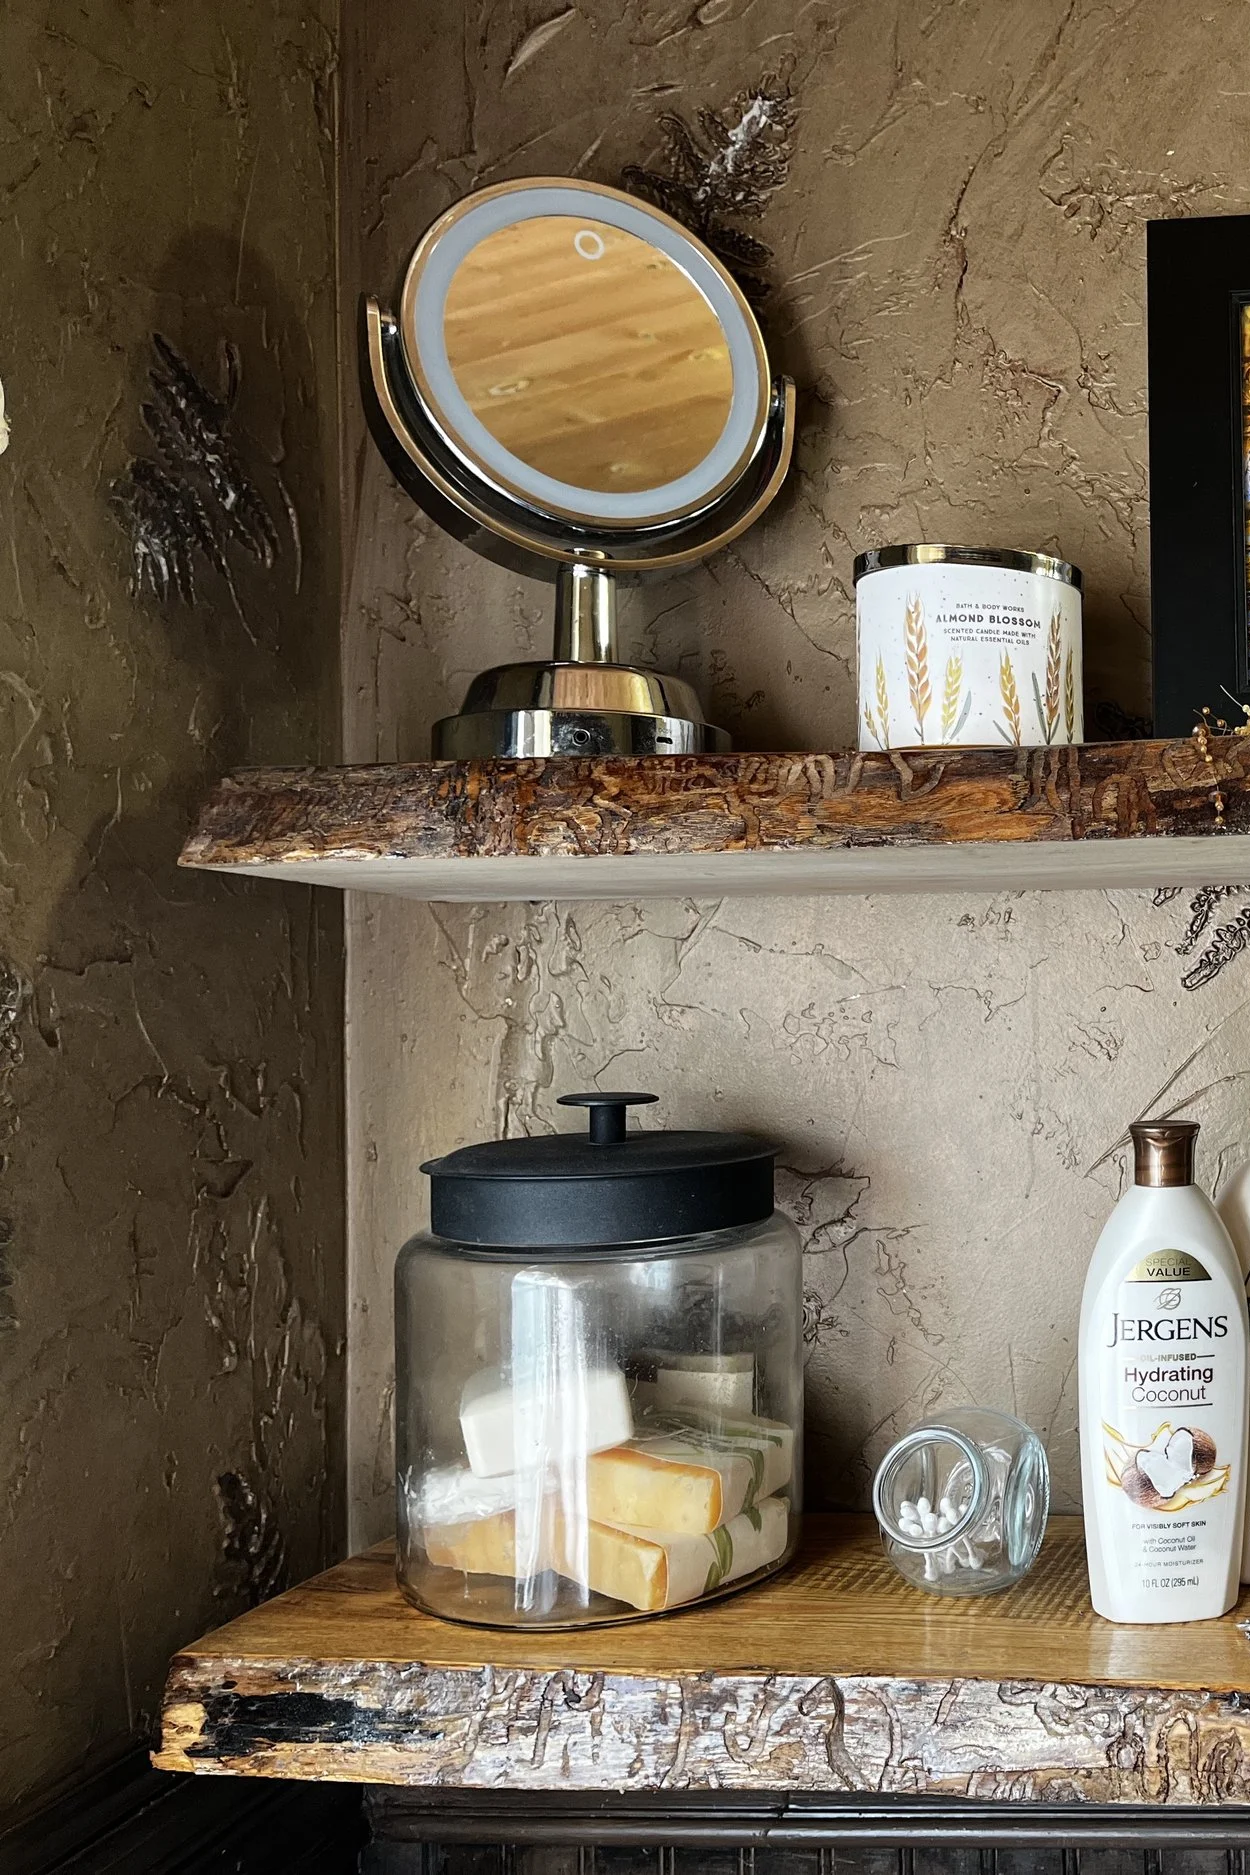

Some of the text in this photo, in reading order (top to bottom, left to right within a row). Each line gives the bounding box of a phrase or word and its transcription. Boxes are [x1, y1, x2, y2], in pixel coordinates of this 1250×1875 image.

[1002, 605, 1024, 613] WORKS
[936, 614, 1041, 629] ALMOND BLOSSOM
[980, 636, 1014, 644] ESSENTIAL
[1021, 631, 1036, 639] WITH
[1145, 1257, 1192, 1267] SPECIAL
[1146, 1267, 1192, 1277] VALUE
[1106, 1312, 1228, 1348] JERGENS
[1124, 1366, 1214, 1386] Hydrating
[1132, 1385, 1207, 1402] Coconut
[1149, 1545, 1177, 1553] Coconut
[1163, 1559, 1204, 1567] MOISTURIZER
[1142, 1575, 1200, 1588] 10 FL OZ (295 mL)
